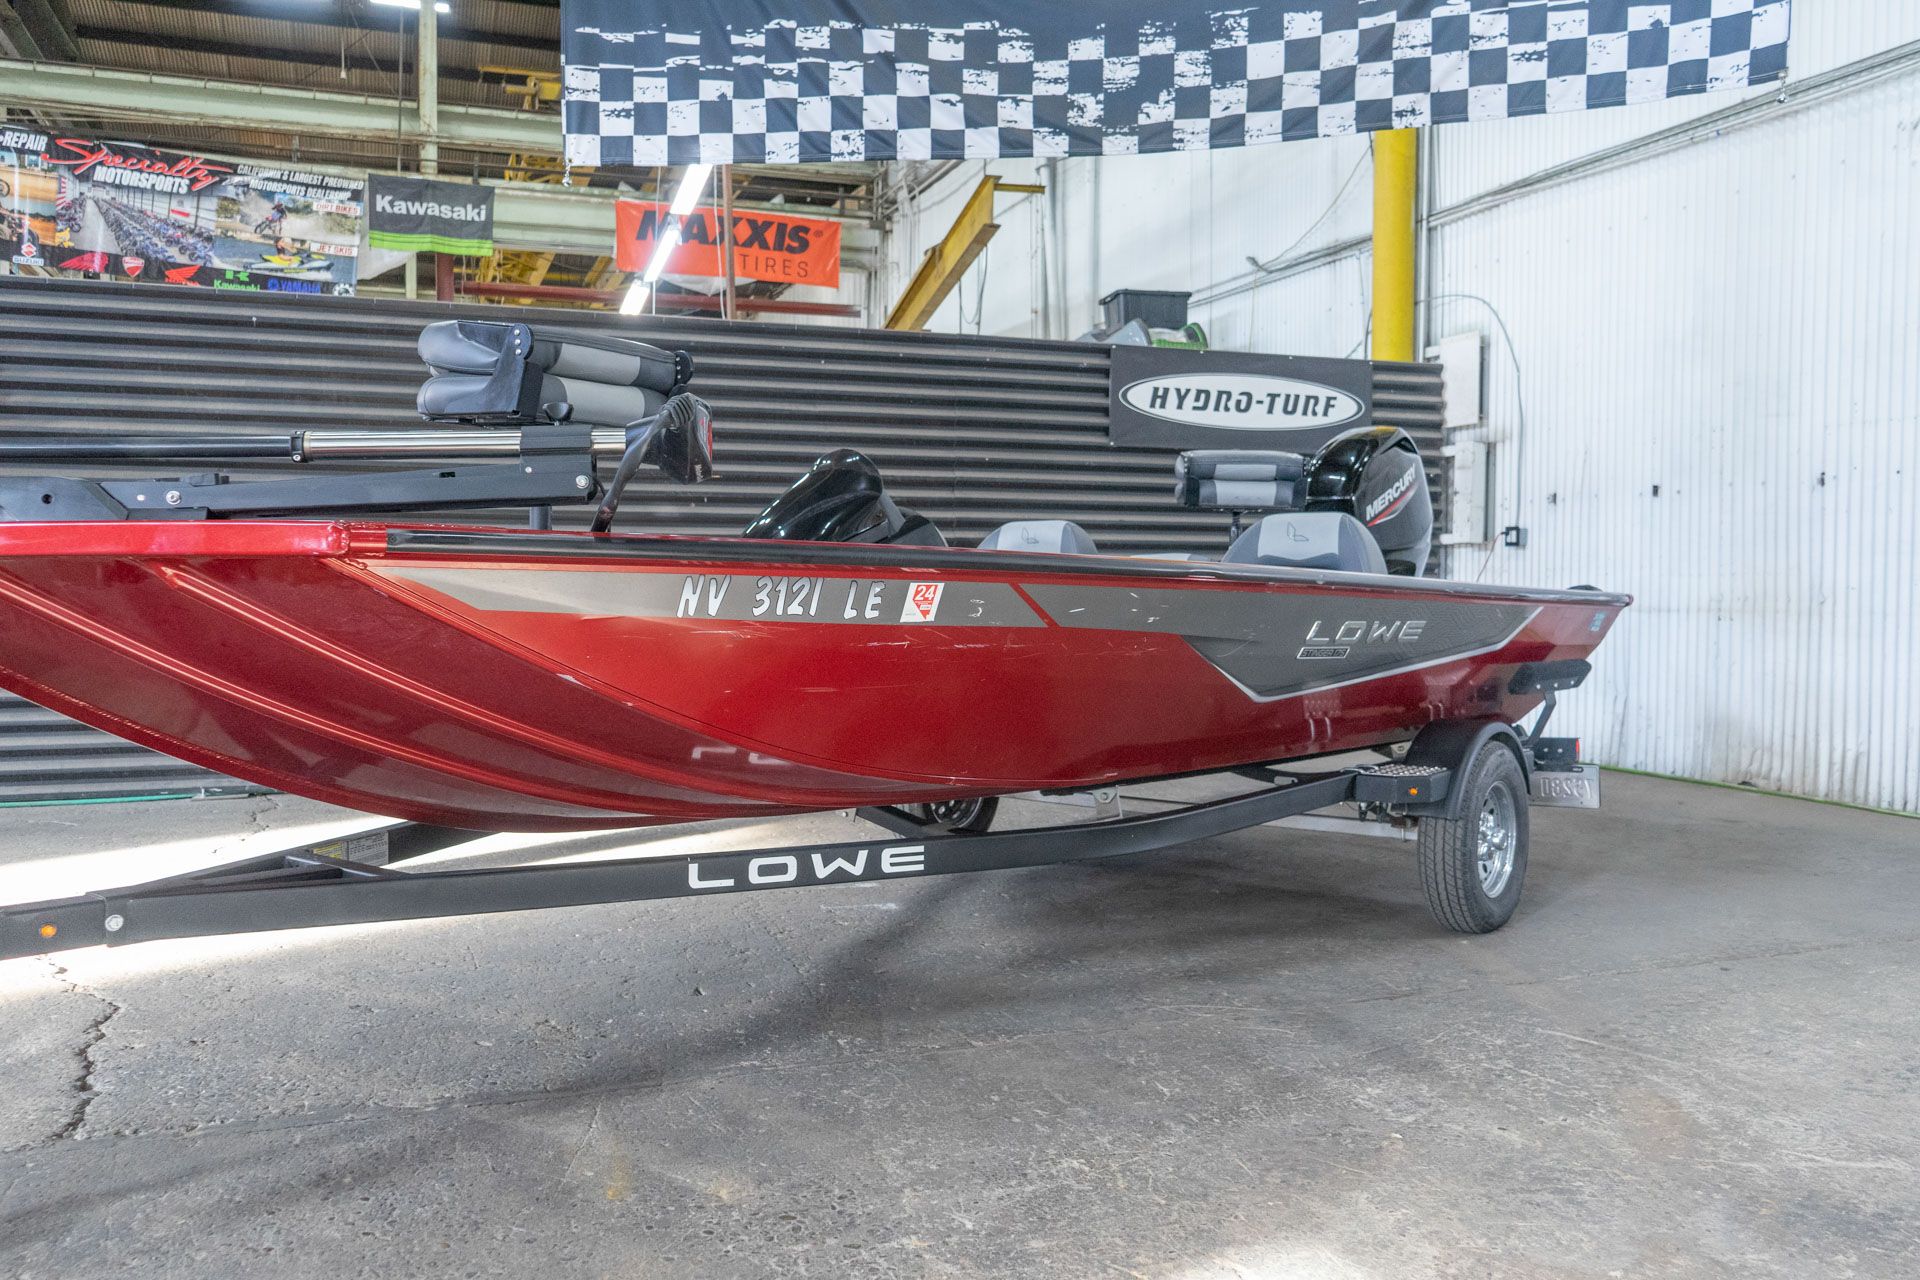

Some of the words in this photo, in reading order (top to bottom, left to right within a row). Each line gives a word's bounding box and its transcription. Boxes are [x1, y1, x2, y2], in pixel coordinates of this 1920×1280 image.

[3, 130, 48, 151] REPAIR
[41, 138, 234, 192] Specialty
[93, 165, 191, 195] MOTORSPORTS
[249, 178, 306, 196] MOTORSPORTS
[306, 187, 352, 201] DEALERSHIP
[289, 171, 322, 185] LARGEST
[322, 176, 364, 190] PREOWNED
[375, 193, 487, 222] Kawasaki
[738, 253, 809, 278] TIRES
[1149, 386, 1338, 417] HYDRO-TURF
[1365, 463, 1416, 521] MERCURY
[676, 574, 731, 618] NV
[752, 575, 825, 618] 3121
[843, 579, 886, 619] LE
[915, 584, 935, 601] 24
[1305, 620, 1427, 644] LOWE
[687, 845, 925, 889] LOWE
